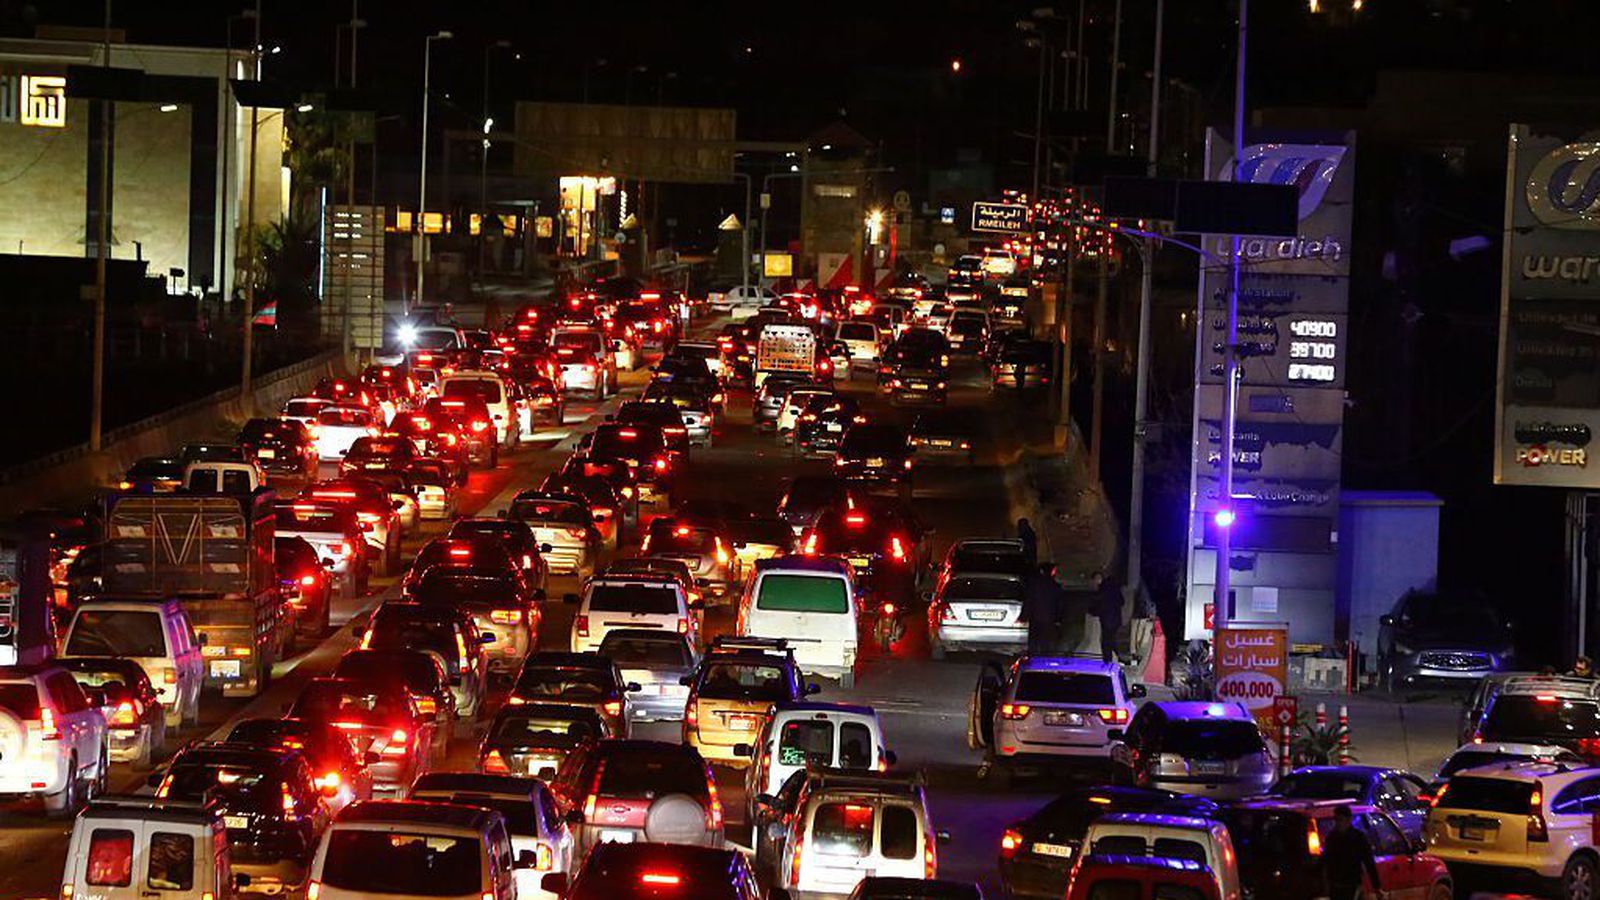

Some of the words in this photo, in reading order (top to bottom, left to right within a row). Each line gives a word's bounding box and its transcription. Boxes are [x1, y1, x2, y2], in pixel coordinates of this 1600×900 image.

[978, 219, 1021, 229] RMEILEH
[1523, 255, 1600, 280] war
[1291, 321, 1336, 336] 40900
[1516, 448, 1586, 464] POWER
[1225, 632, 1276, 649] غسيل
[1221, 652, 1279, 670] سيارات
[1219, 681, 1274, 698] 400,000
